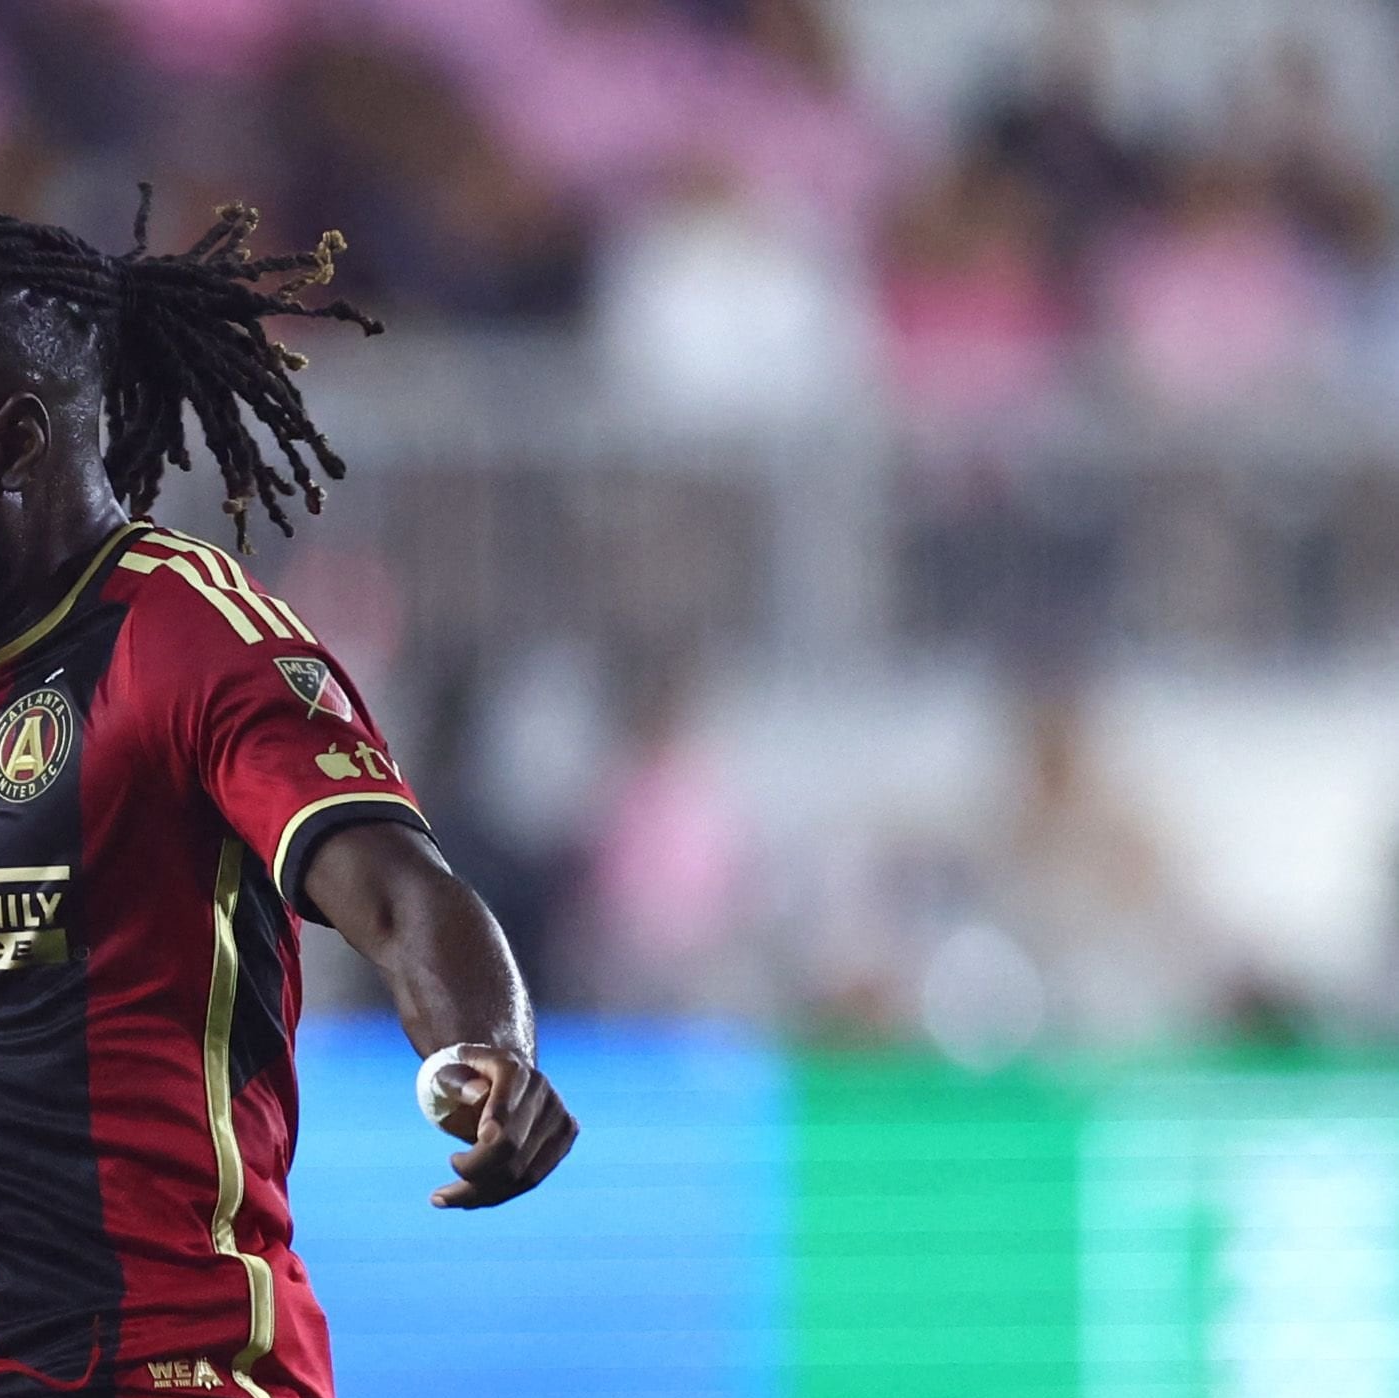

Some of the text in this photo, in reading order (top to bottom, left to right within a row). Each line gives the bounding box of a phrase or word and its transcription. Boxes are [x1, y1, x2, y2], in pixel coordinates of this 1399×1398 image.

[282, 662, 319, 675] MLS
[8, 693, 65, 722] ATLANTA
[40, 764, 58, 785] FC
[147, 1361, 192, 1379] WE
